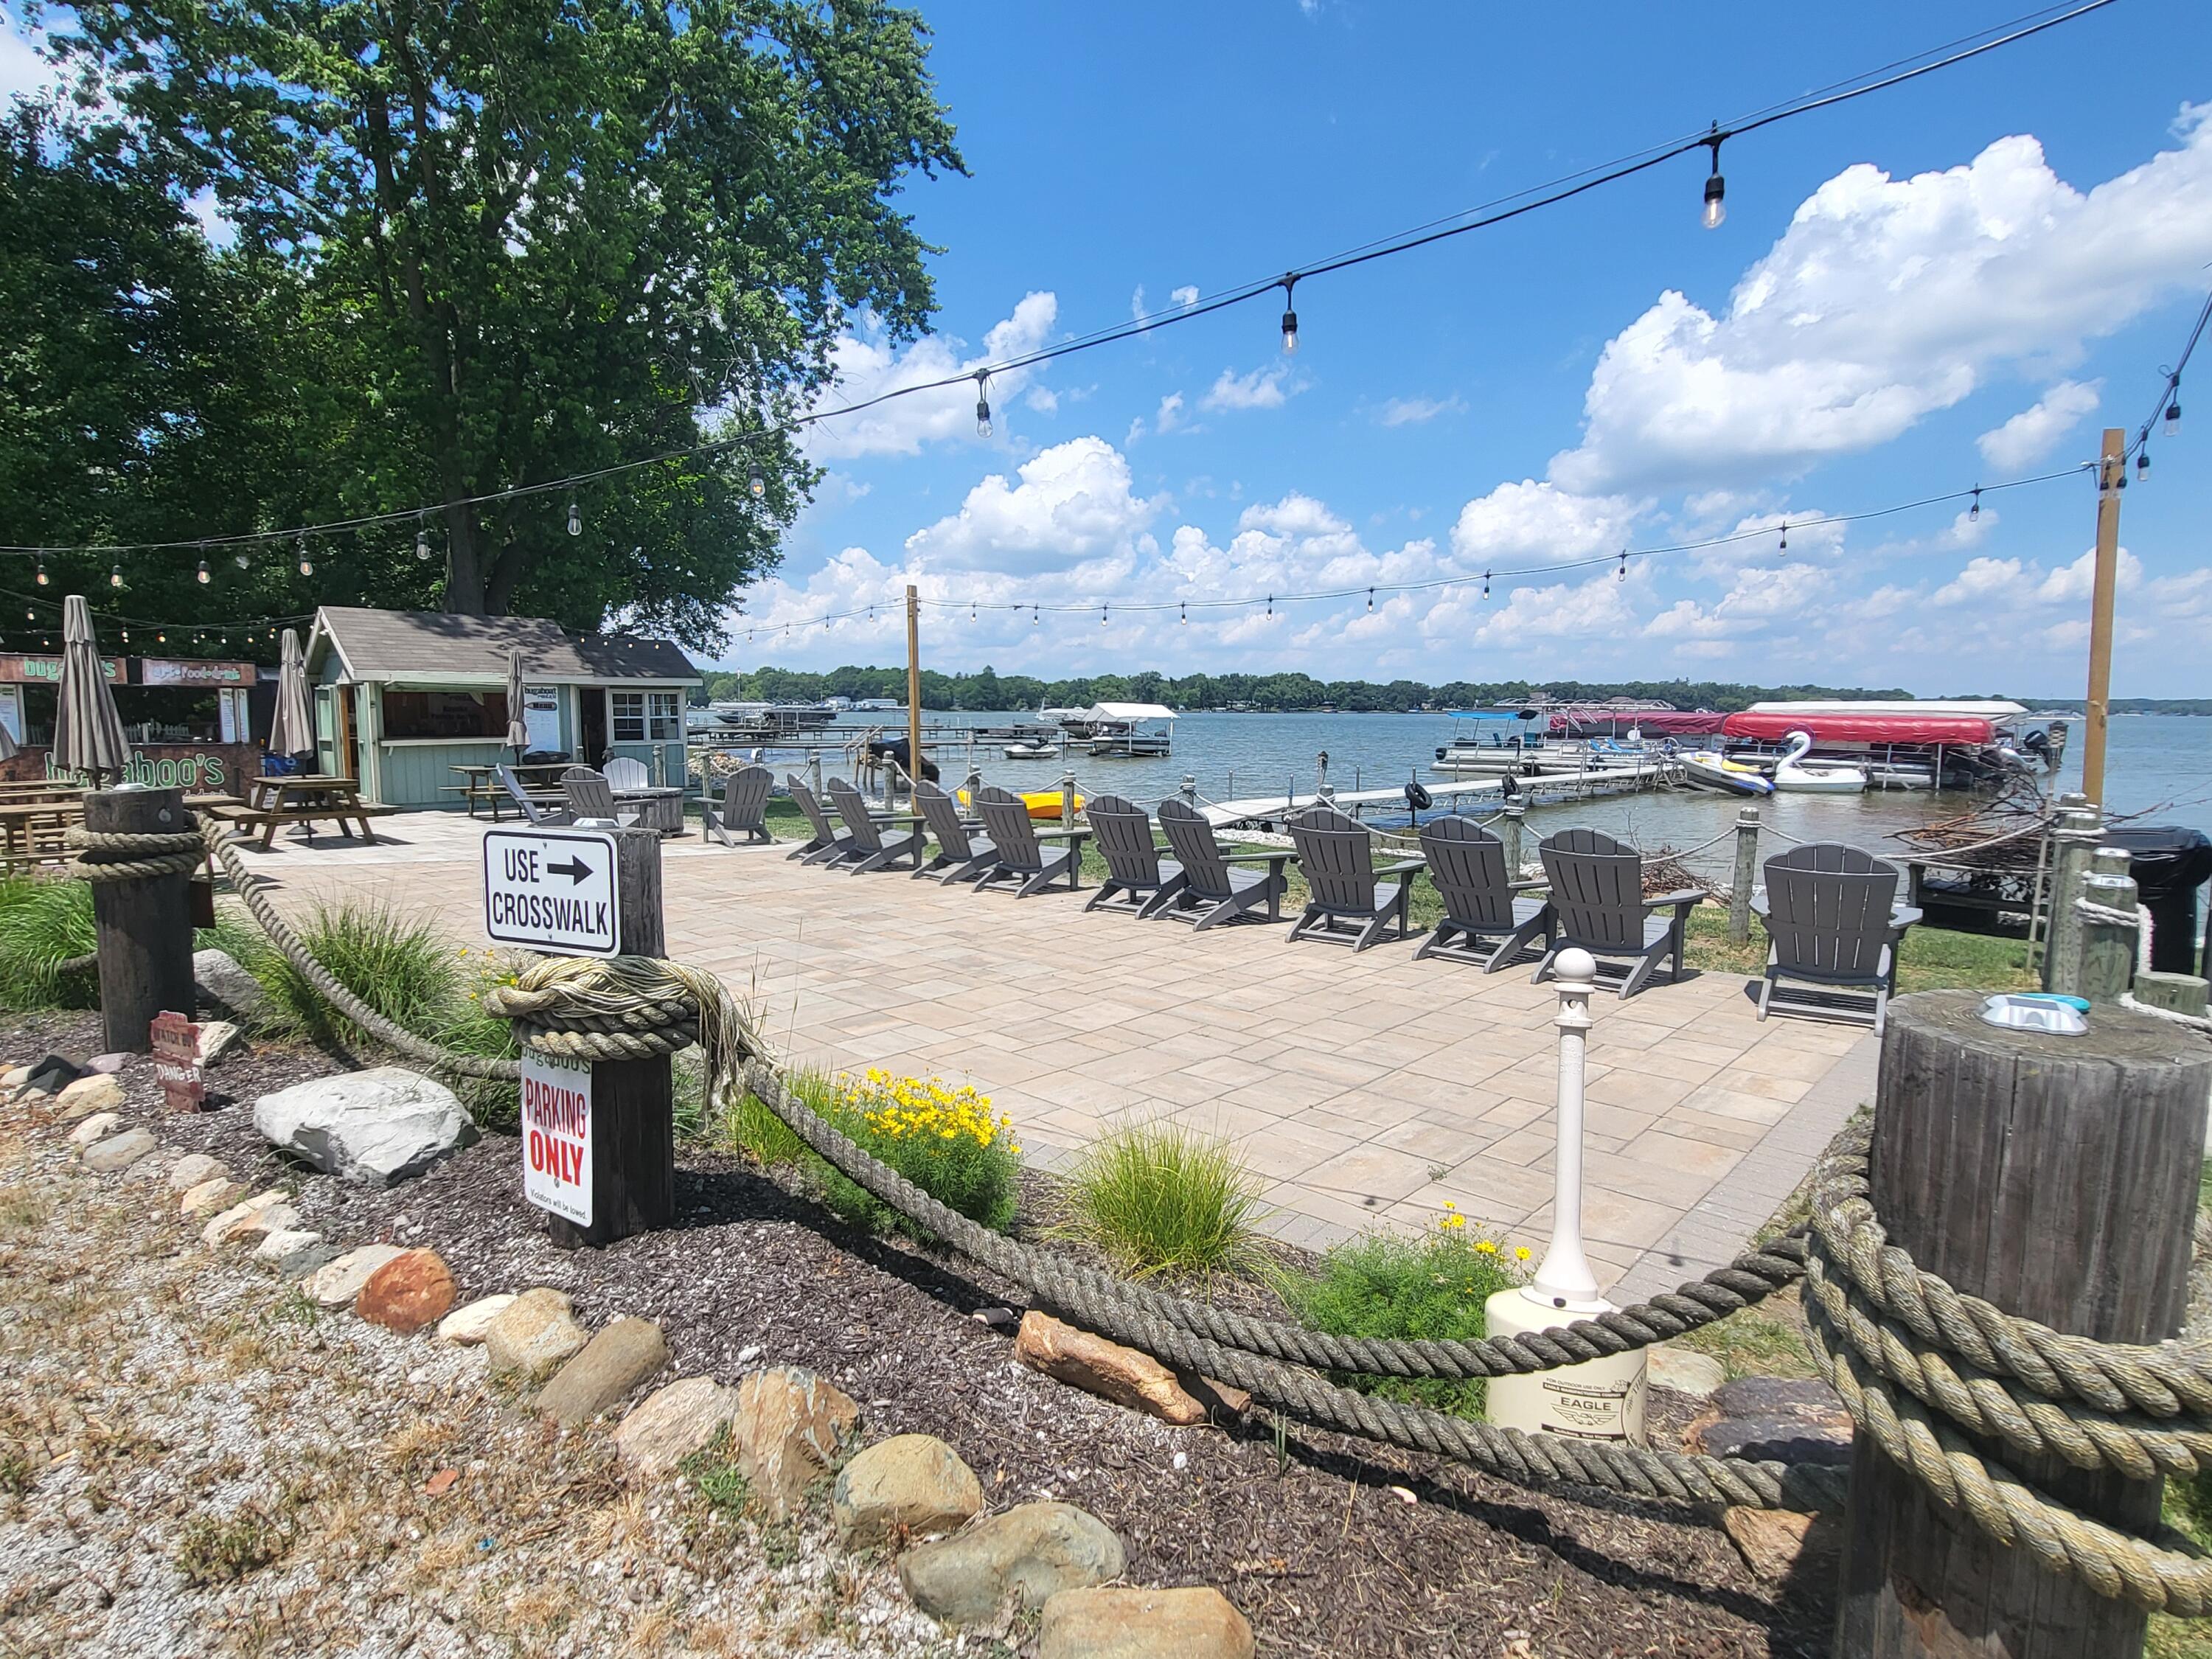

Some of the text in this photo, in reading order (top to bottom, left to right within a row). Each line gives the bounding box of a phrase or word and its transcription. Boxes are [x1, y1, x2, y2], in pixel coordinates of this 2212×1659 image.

[504, 848, 540, 883] USE
[493, 891, 608, 936] CROSSWALK
[156, 1064, 201, 1082] DANGER
[526, 1077, 585, 1140] PARKING
[530, 1130, 584, 1187] ONLY
[530, 1188, 552, 1205] Violators
[553, 1199, 562, 1208] will
[563, 1201, 568, 1212] be
[1557, 1380, 1582, 1388] OUTDOOR
[1561, 1397, 1611, 1411] EAGLE
